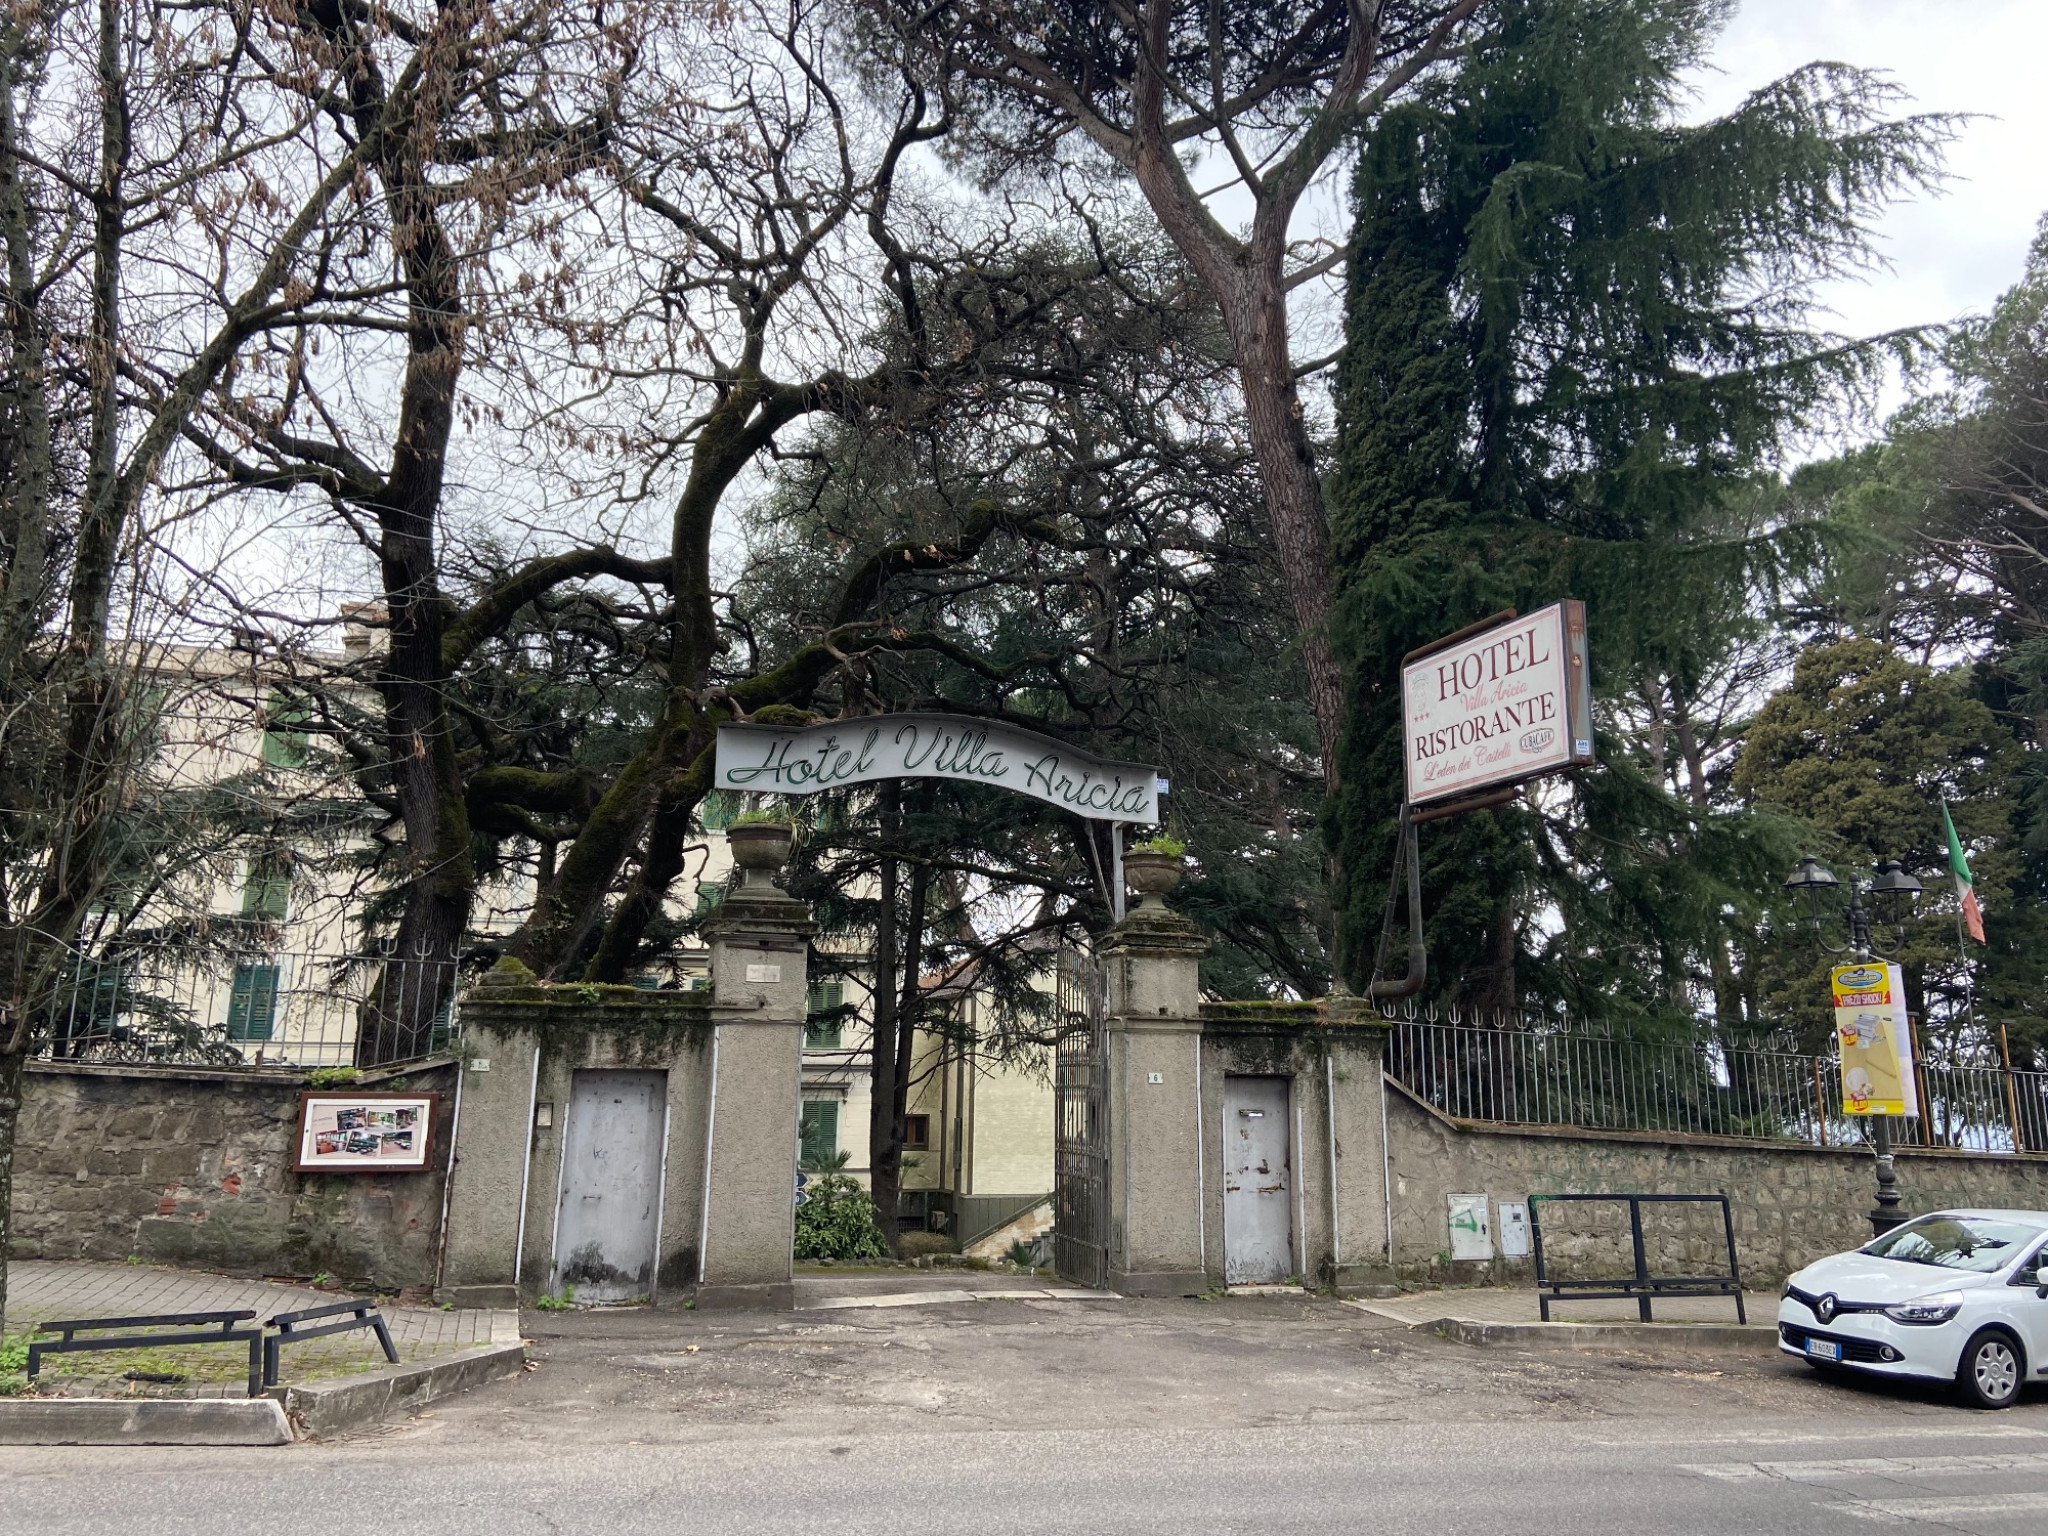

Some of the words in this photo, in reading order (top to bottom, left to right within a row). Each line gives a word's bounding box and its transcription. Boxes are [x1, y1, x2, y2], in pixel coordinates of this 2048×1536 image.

[1438, 628, 1549, 701] HOTEL
[1460, 682, 1488, 712] Villa
[1490, 680, 1529, 704] Aricia
[1415, 691, 1556, 761] RISTORANTE
[727, 727, 880, 784] Hotel
[896, 723, 1009, 777] Villa
[1024, 754, 1149, 813] Aricia
[1153, 1074, 1158, 1082] 6
